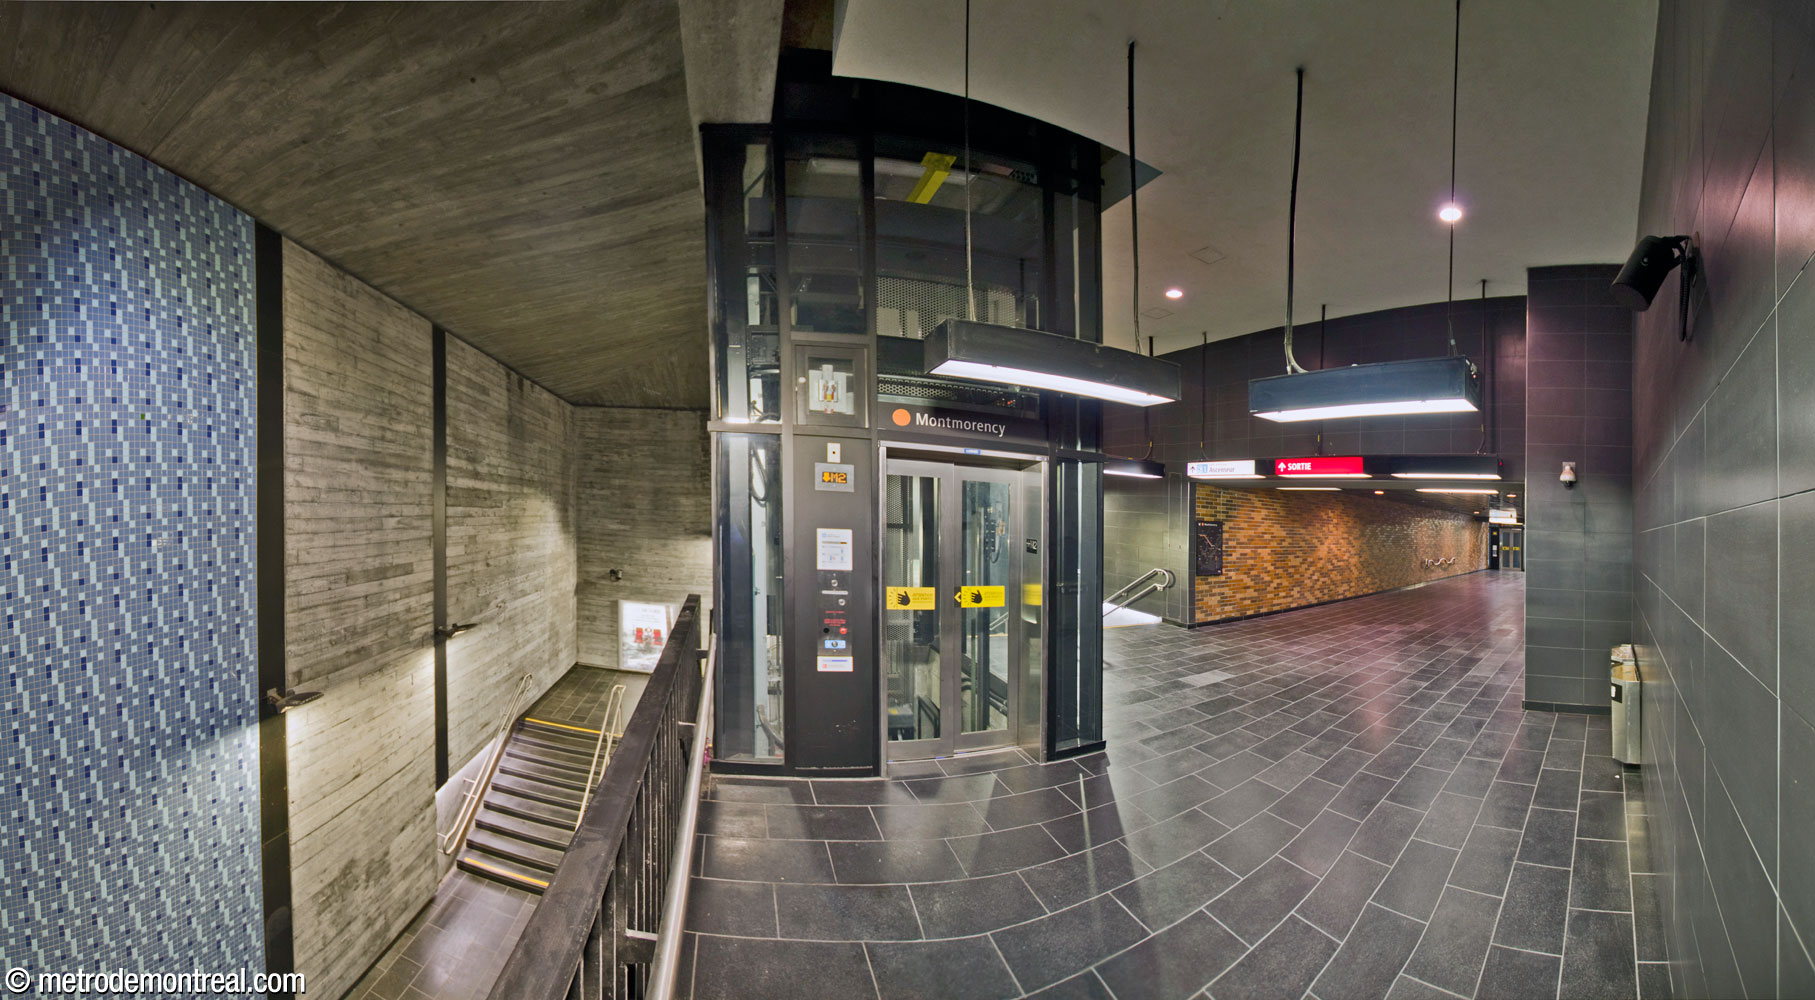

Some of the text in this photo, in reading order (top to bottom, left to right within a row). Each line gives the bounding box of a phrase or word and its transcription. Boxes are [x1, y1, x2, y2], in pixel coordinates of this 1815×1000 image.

[916, 412, 1006, 437] Montmorency
[1287, 462, 1312, 471] SORTIE
[830, 472, 847, 484] M2
